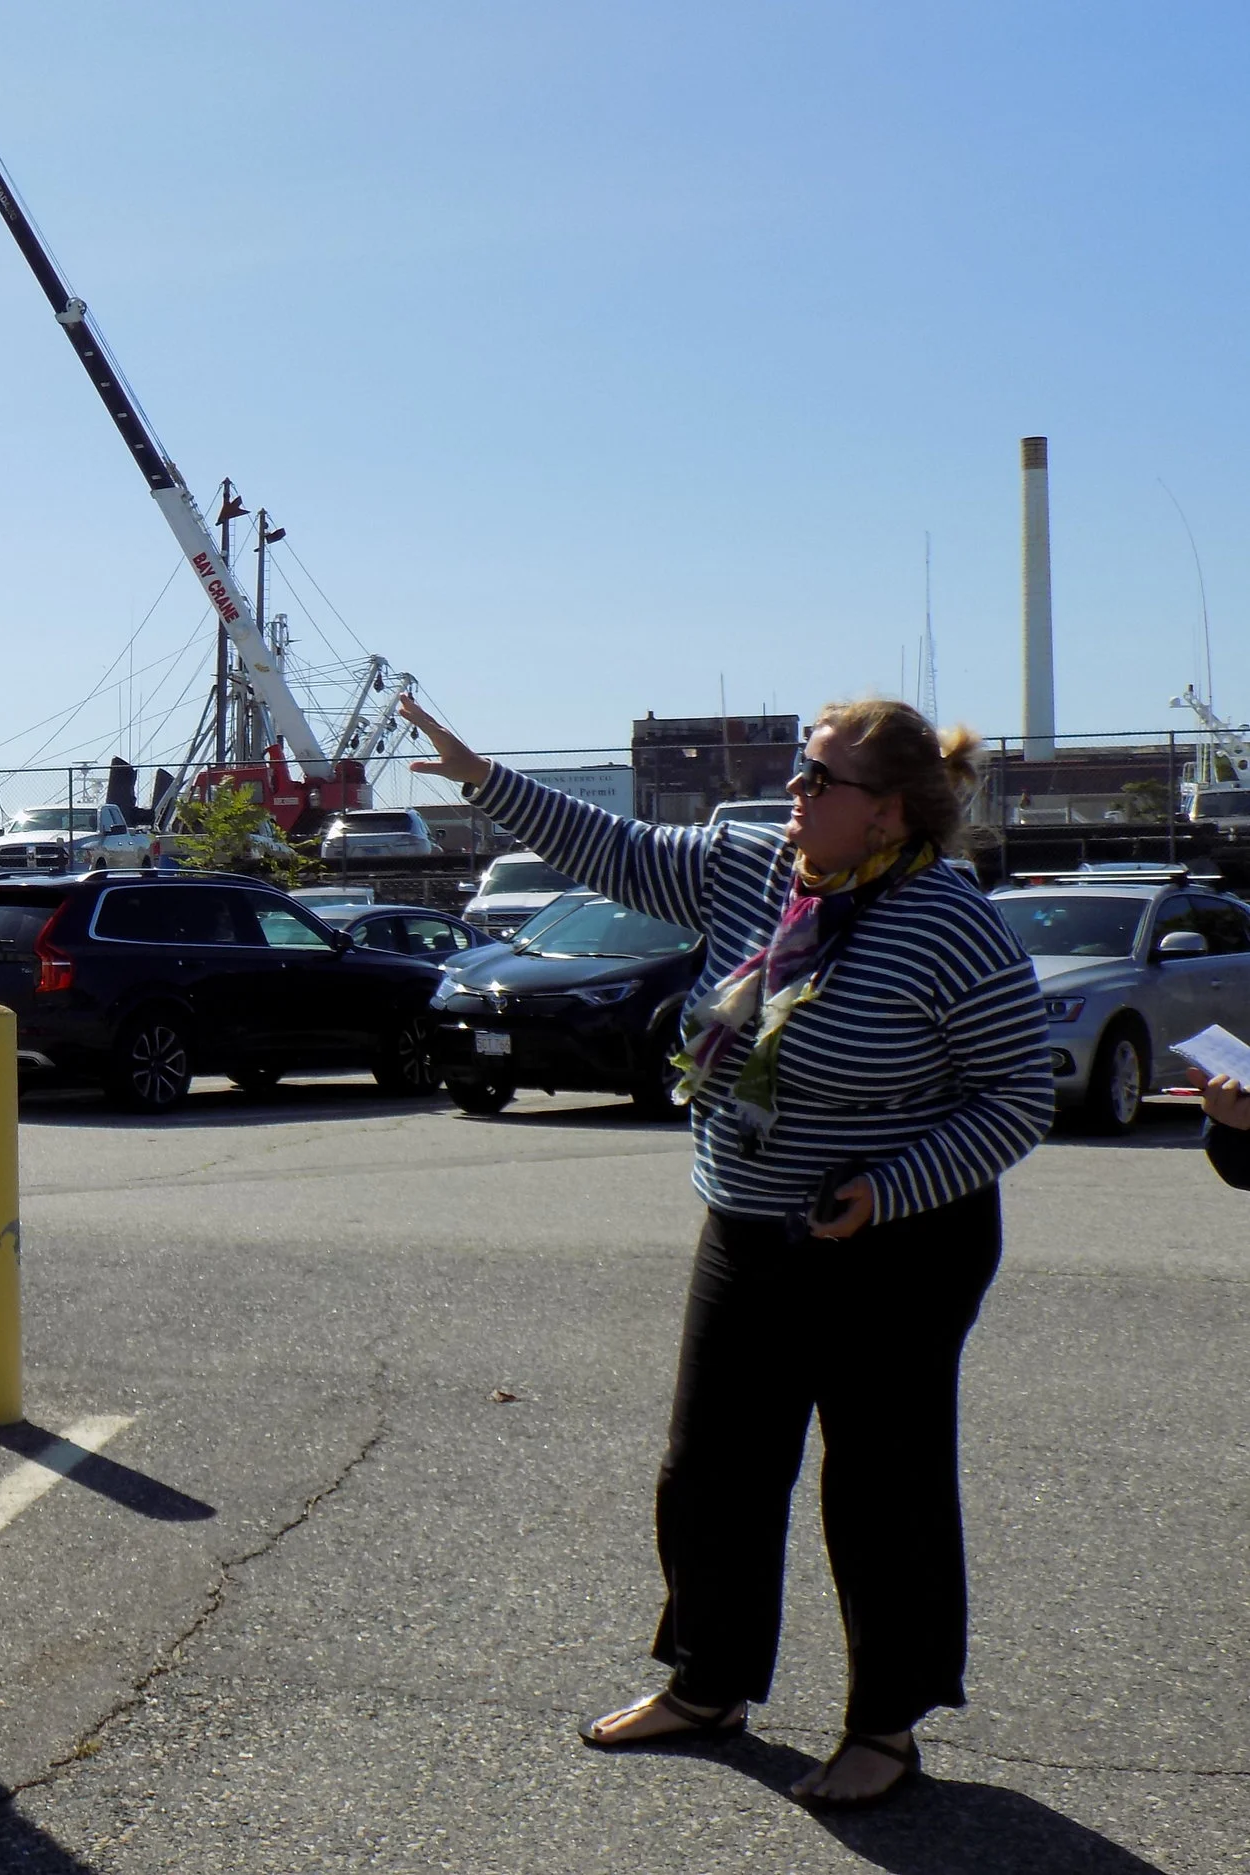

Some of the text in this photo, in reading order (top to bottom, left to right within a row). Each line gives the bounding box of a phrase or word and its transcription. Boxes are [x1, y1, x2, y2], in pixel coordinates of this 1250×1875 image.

[193, 552, 240, 624] BAY CRANE
[579, 787, 616, 797] Permit
